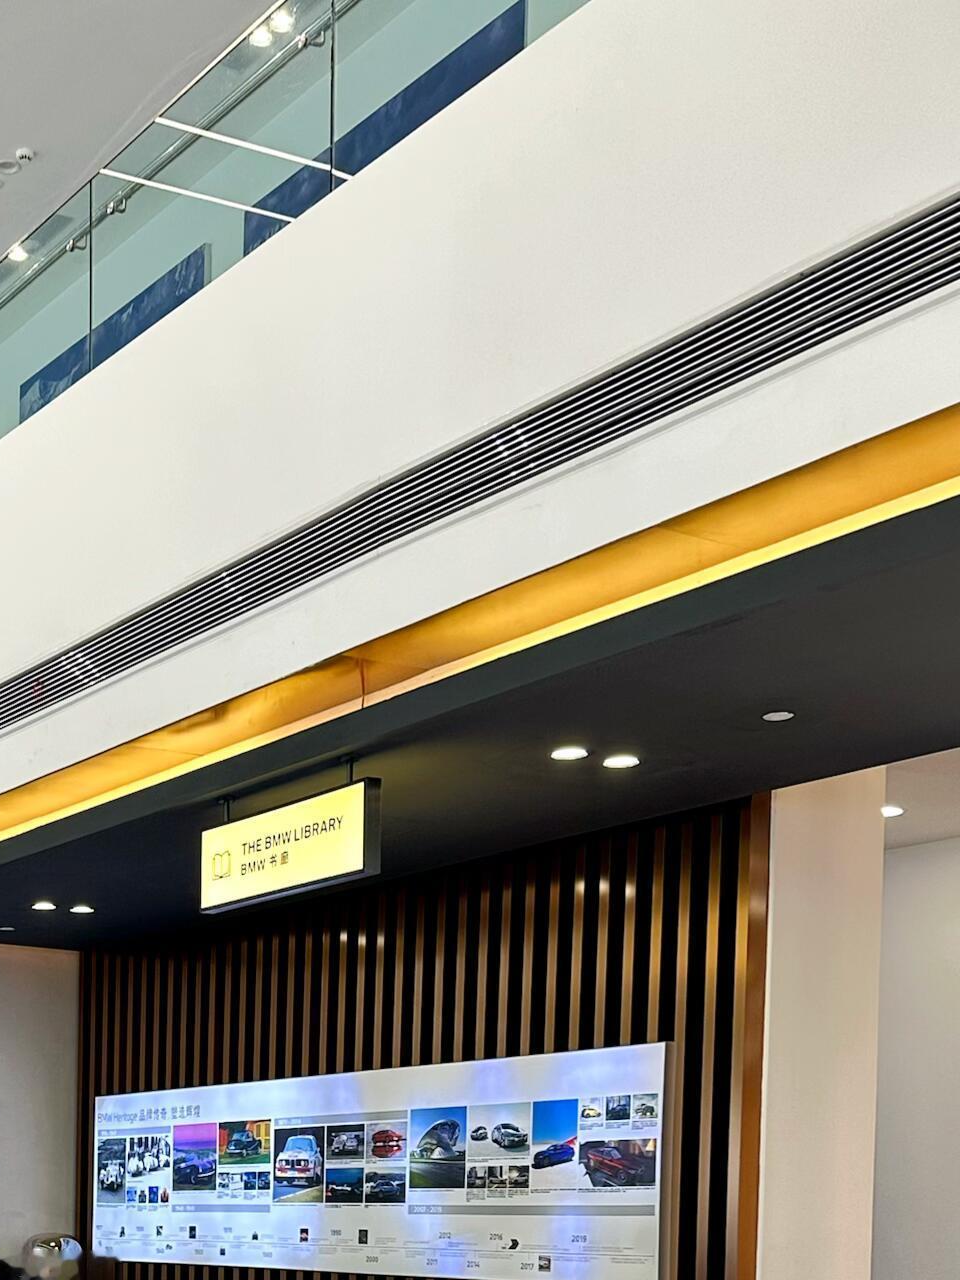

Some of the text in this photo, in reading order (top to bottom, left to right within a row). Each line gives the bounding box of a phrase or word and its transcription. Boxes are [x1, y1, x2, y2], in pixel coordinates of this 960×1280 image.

[242, 815, 344, 856] THE BMW LIBRARY
[240, 858, 266, 876] BMW
